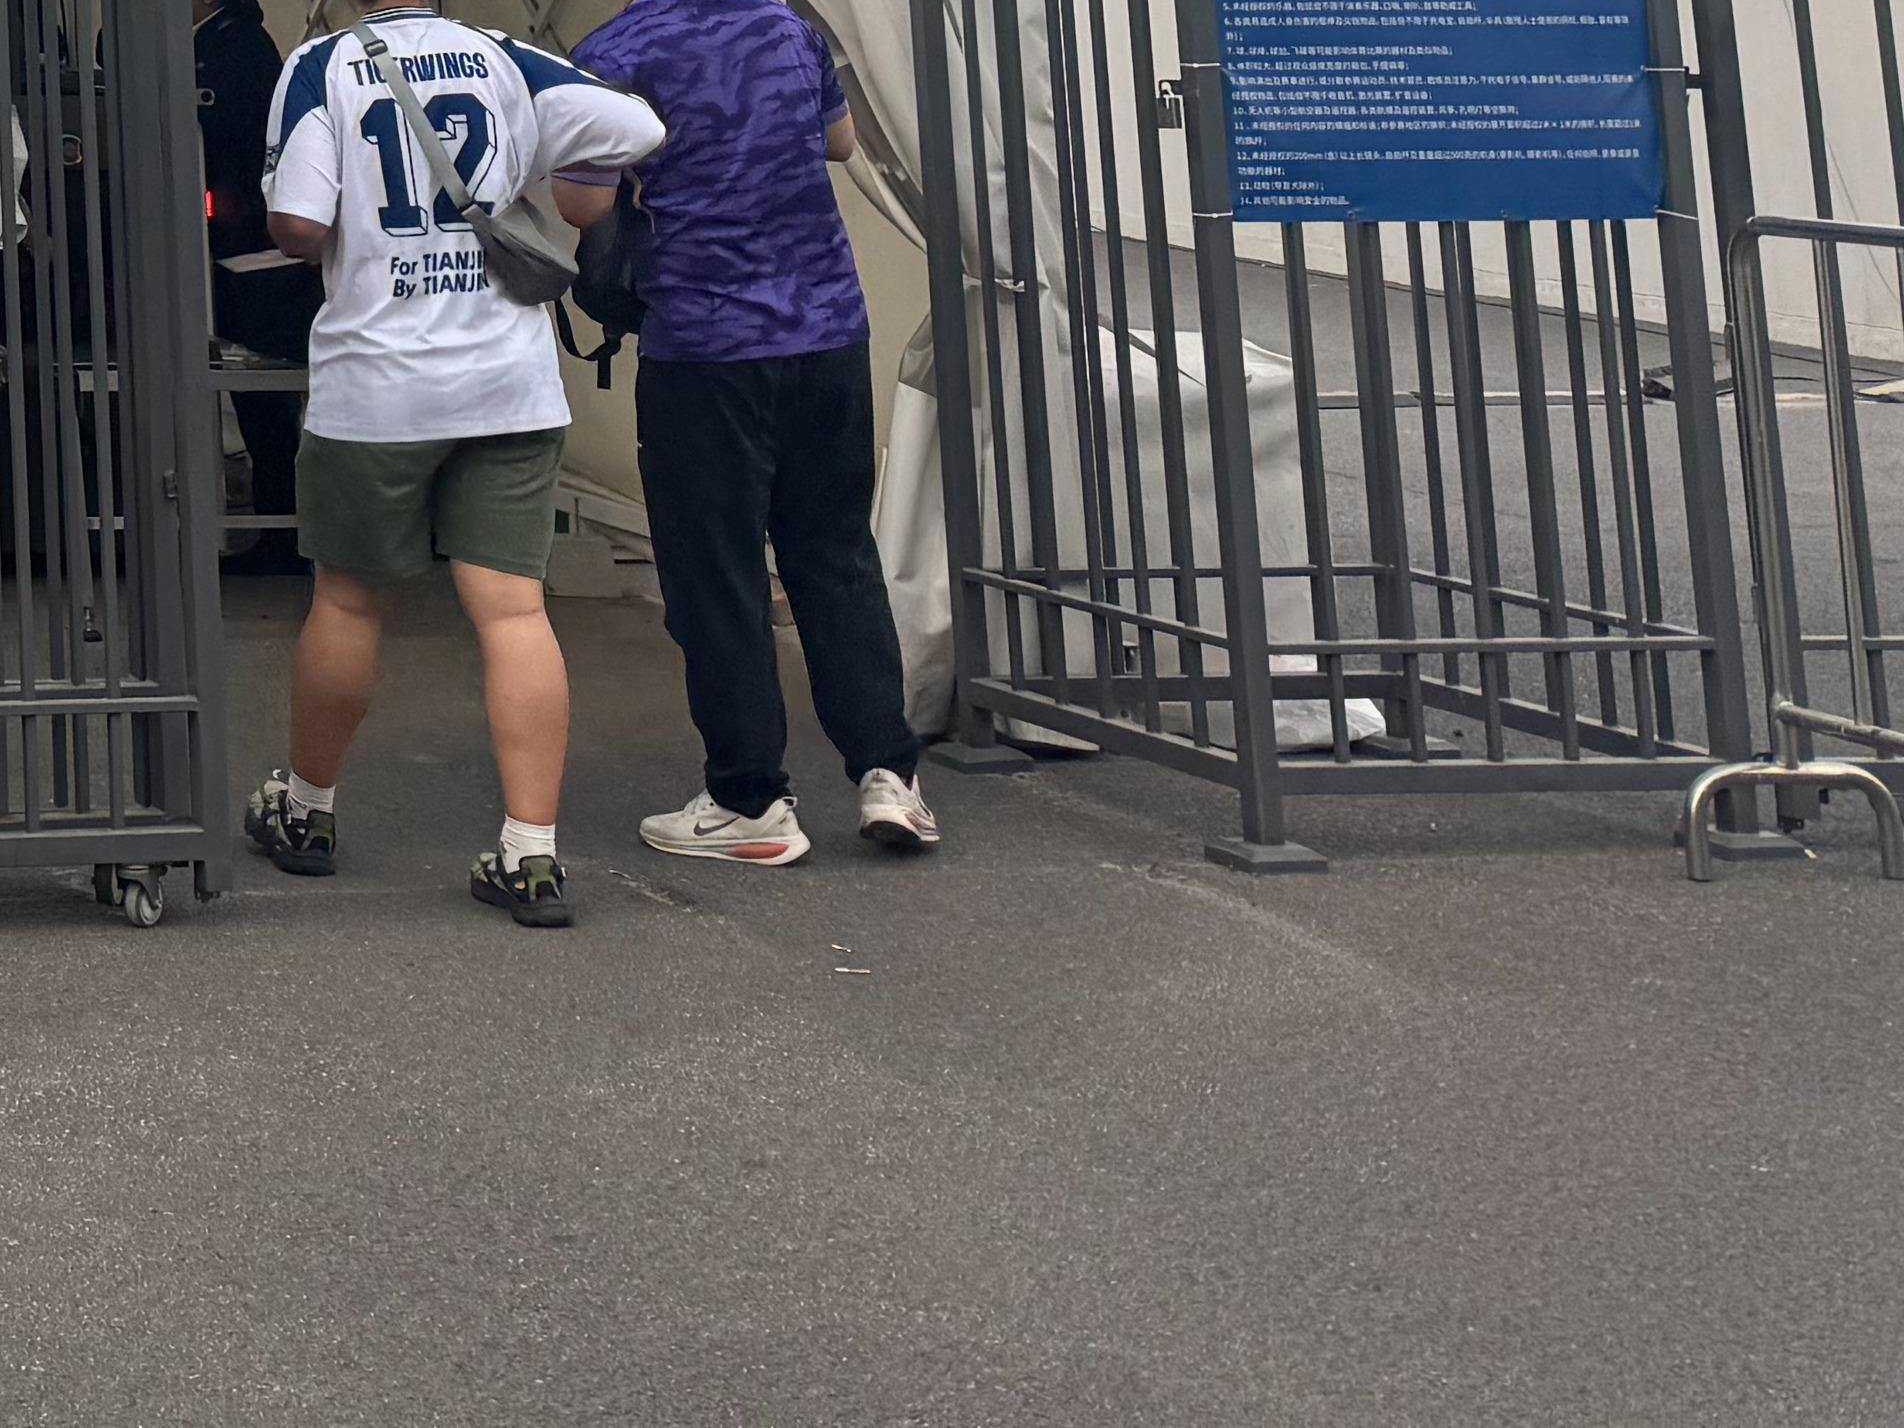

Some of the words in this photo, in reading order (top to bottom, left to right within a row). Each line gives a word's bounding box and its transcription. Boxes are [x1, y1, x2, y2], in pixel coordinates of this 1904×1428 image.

[347, 52, 489, 86] TIRWINGS
[360, 93, 498, 238] 12
[391, 256, 418, 275] For
[423, 250, 486, 272] TIANJI
[393, 278, 417, 300] By
